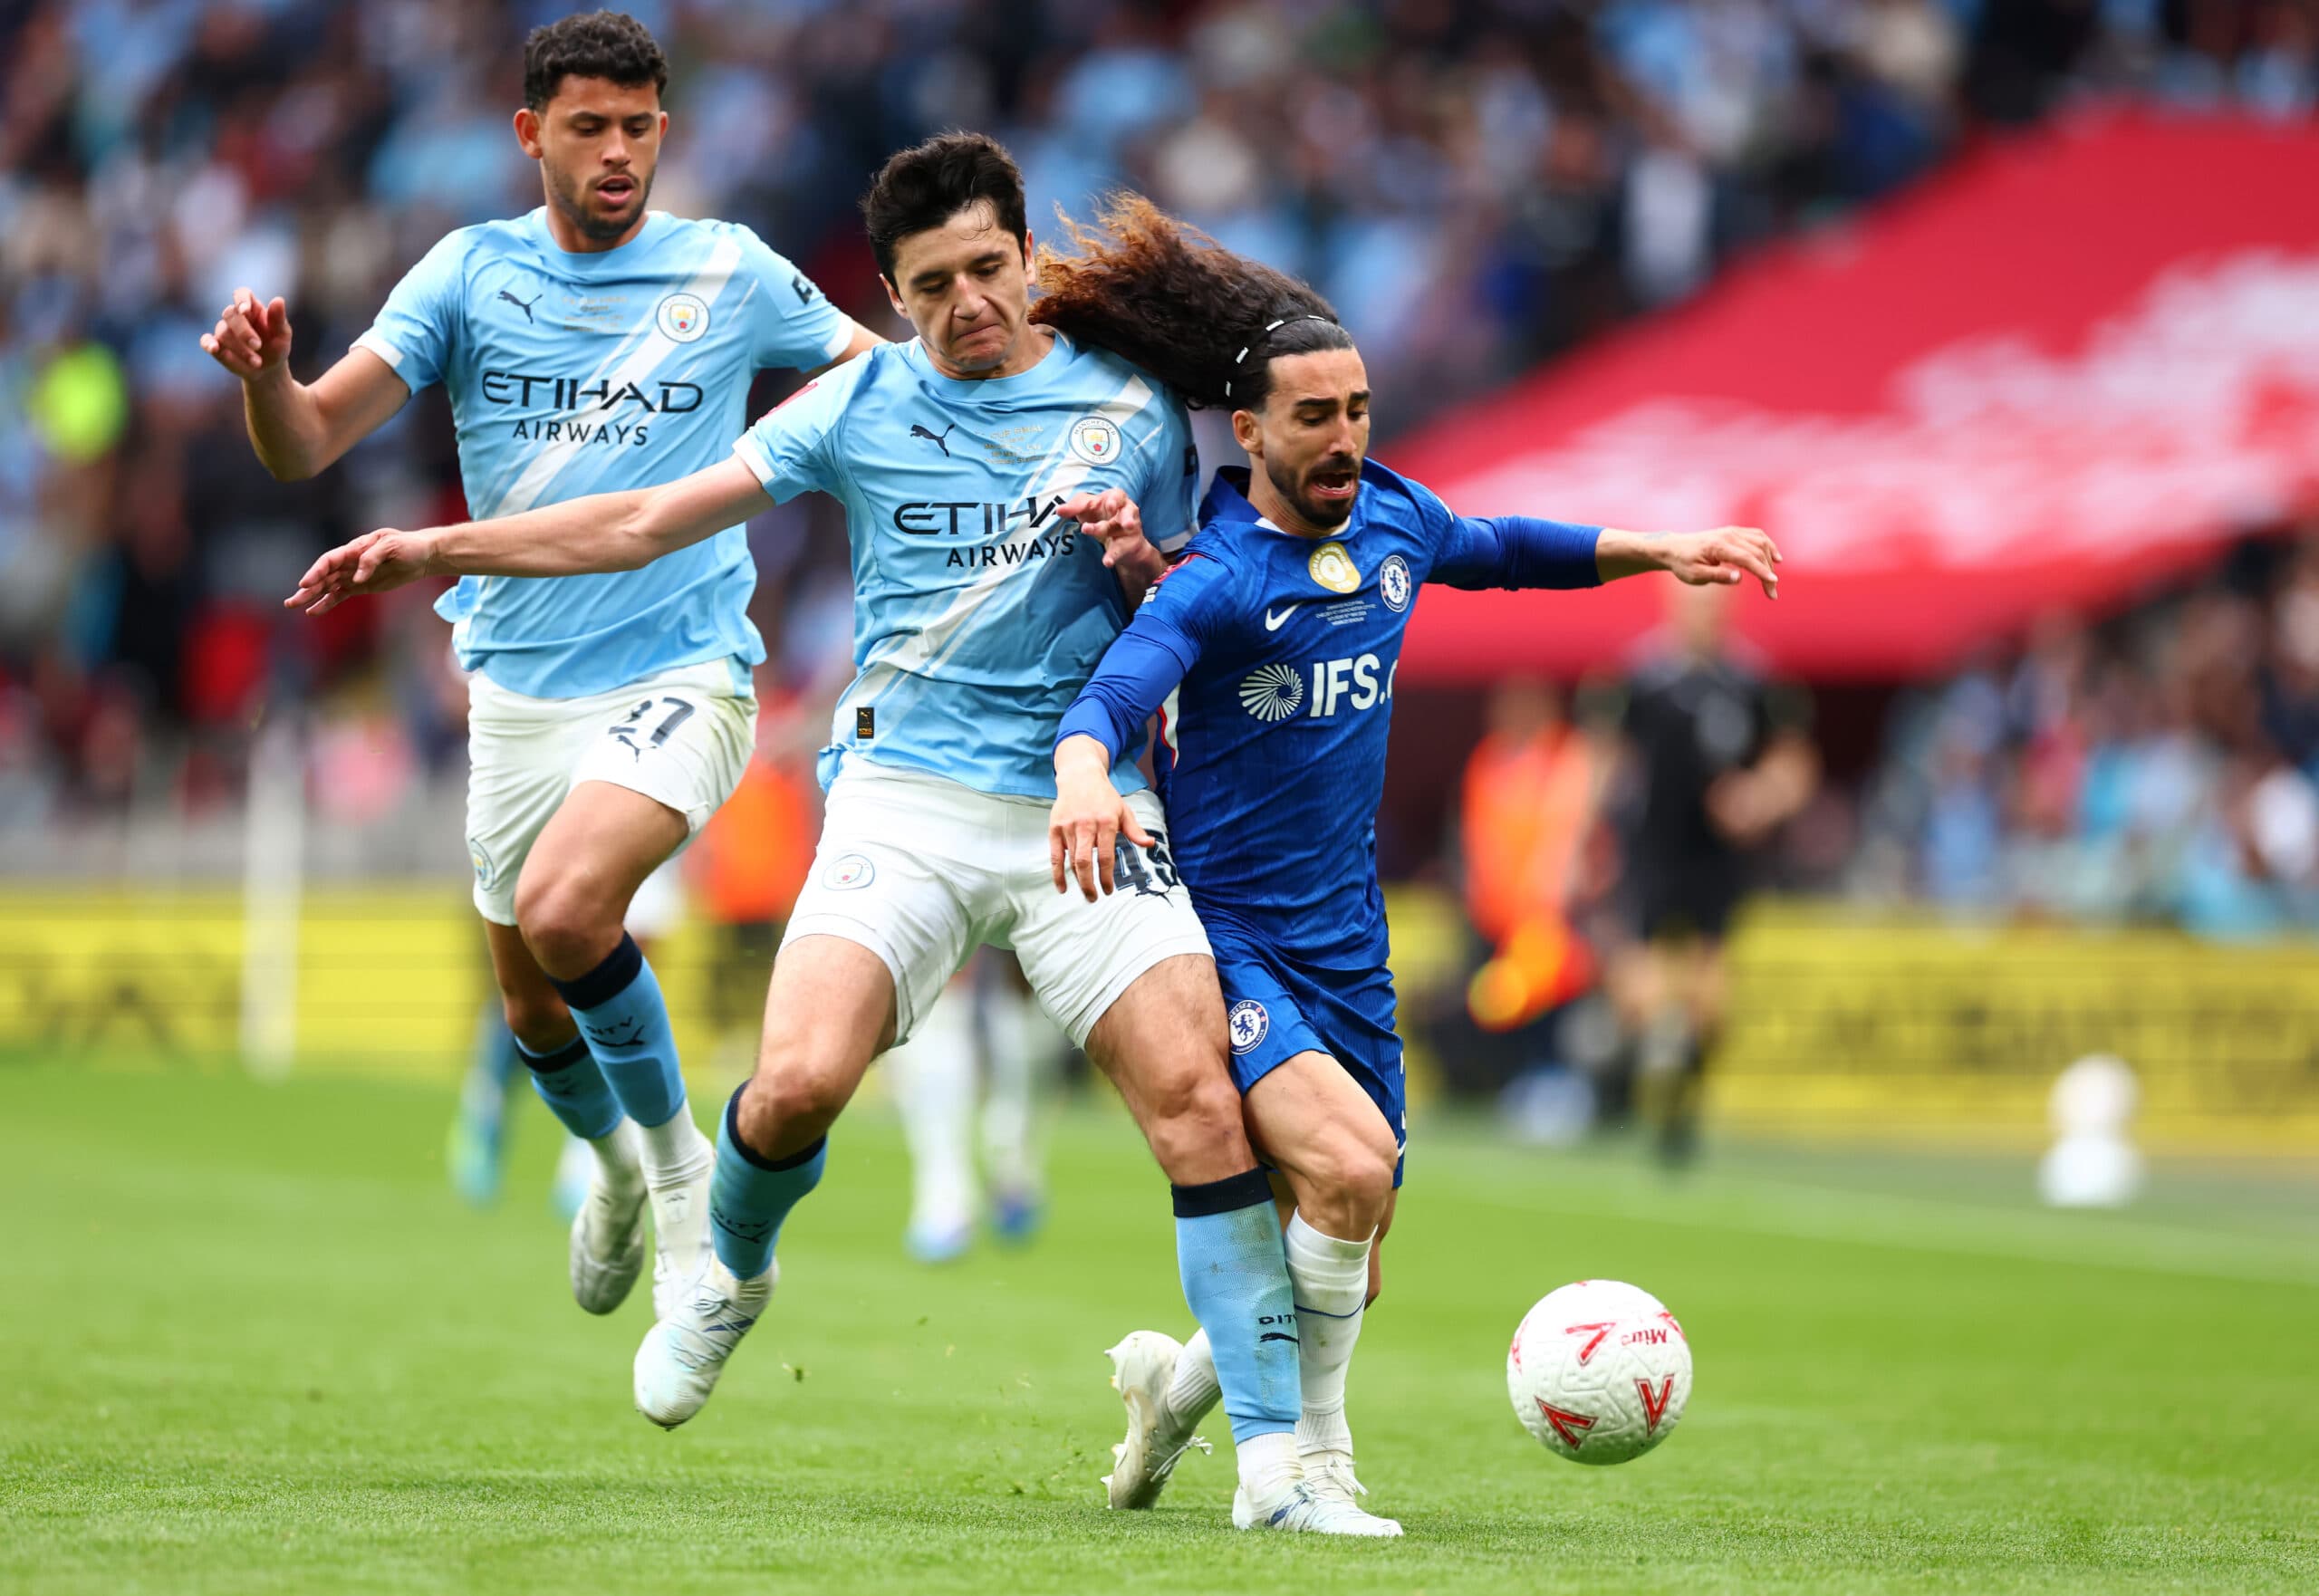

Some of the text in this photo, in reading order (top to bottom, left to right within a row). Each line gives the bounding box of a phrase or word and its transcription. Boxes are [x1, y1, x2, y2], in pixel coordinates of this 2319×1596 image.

[482, 370, 704, 414] ETIHAD
[512, 419, 650, 447] AIRWAYS
[893, 495, 1080, 536] ETIHA
[946, 534, 1075, 568] AIRWAYS
